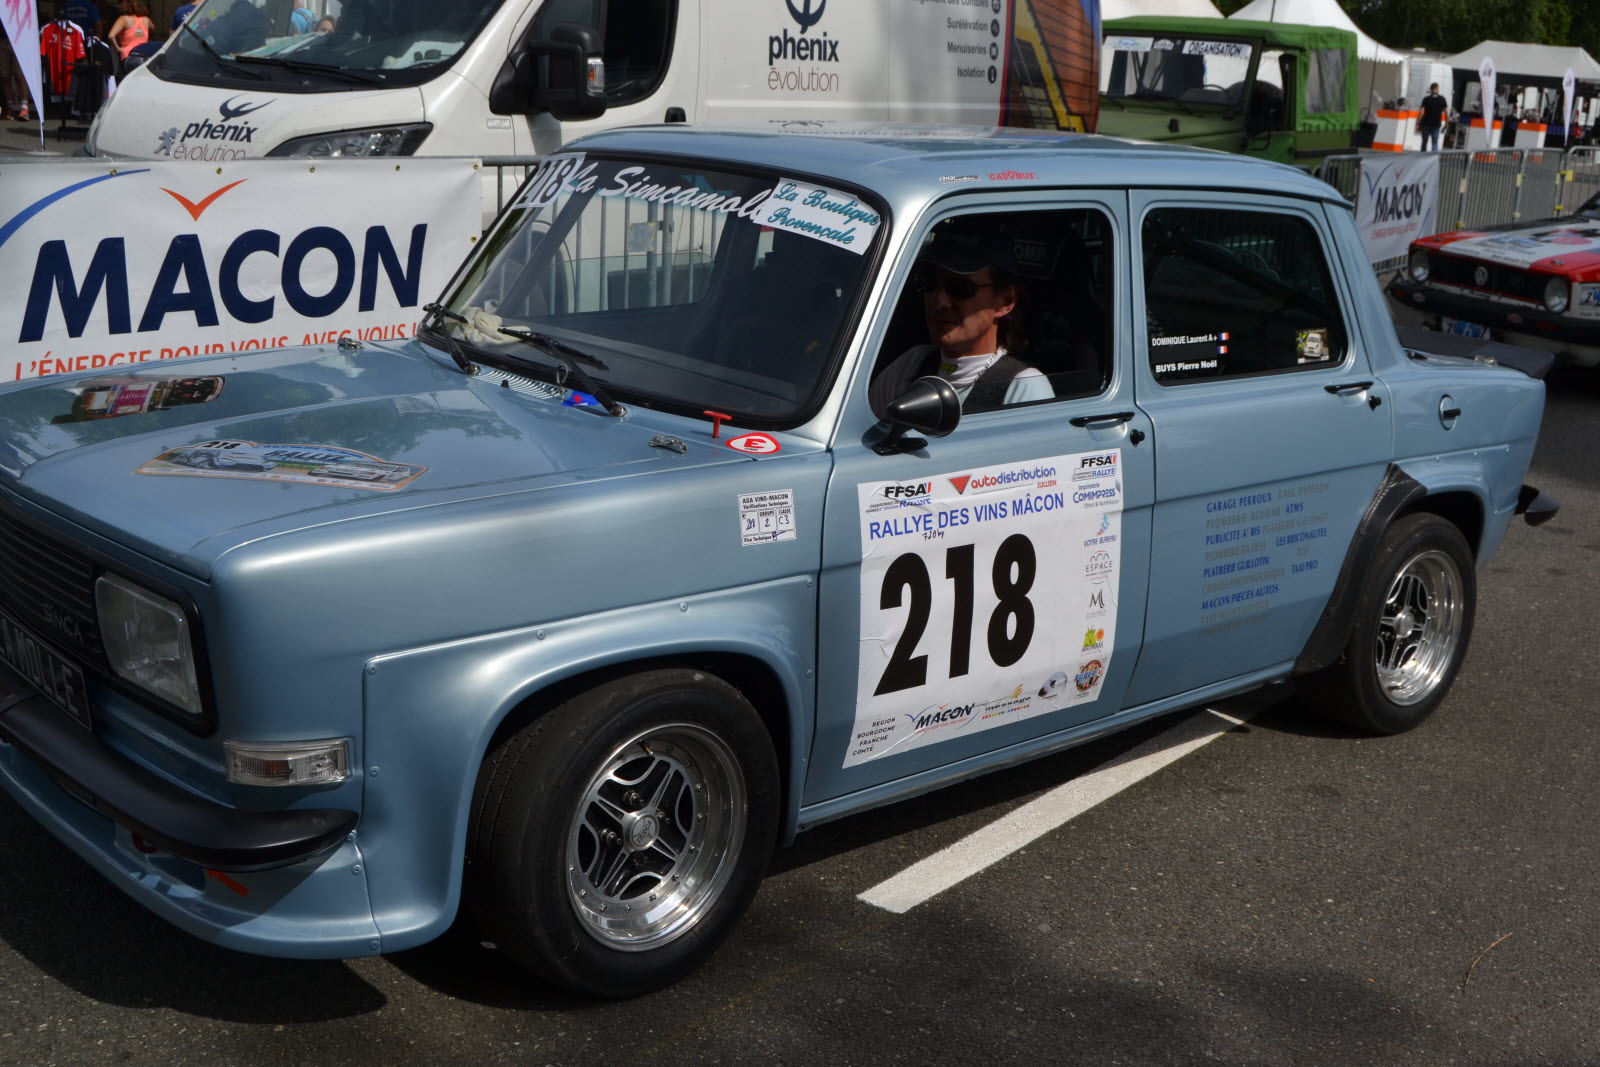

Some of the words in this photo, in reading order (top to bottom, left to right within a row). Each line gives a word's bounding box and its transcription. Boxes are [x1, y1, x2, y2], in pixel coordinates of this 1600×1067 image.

[947, 41, 987, 55] Menuiseries
[1188, 41, 1241, 57] ORGANISATION
[957, 66, 986, 78] Isolation
[773, 182, 799, 202] La
[801, 189, 881, 226] Boutique
[767, 207, 855, 245] Provençale
[1152, 335, 1187, 346] DOMINIQUE
[1187, 334, 1208, 344] Laurent
[1155, 363, 1177, 373] BUYS
[1177, 362, 1200, 371] Pierre
[1200, 360, 1217, 369] Noël
[1081, 456, 1112, 468] FFSA
[971, 467, 1056, 489] autodistribution
[1092, 468, 1115, 477] RALLYE
[755, 493, 789, 502] VINS-MACON
[884, 484, 927, 498] FFSA
[1206, 498, 1237, 513] GARAGE
[1239, 492, 1272, 507] PERROUX
[1286, 501, 1304, 513] ATMS
[869, 513, 933, 540] RALLYE
[938, 510, 969, 529] DES
[974, 502, 1008, 522] VINS
[1012, 492, 1064, 516] MÂCON
[1205, 529, 1241, 545] PUBLICITE
[1250, 526, 1261, 537] BIS
[1276, 536, 1286, 547] LES
[1286, 527, 1328, 545] BRICONAUTES
[1085, 561, 1112, 573] ESPACE
[1203, 561, 1237, 579] PLATRERIE
[1237, 556, 1270, 572] GUILLOTIN
[1202, 595, 1230, 610] MACON
[1231, 590, 1254, 603] PIECES
[1255, 584, 1280, 598] AUTOS
[873, 533, 1036, 697] 218
